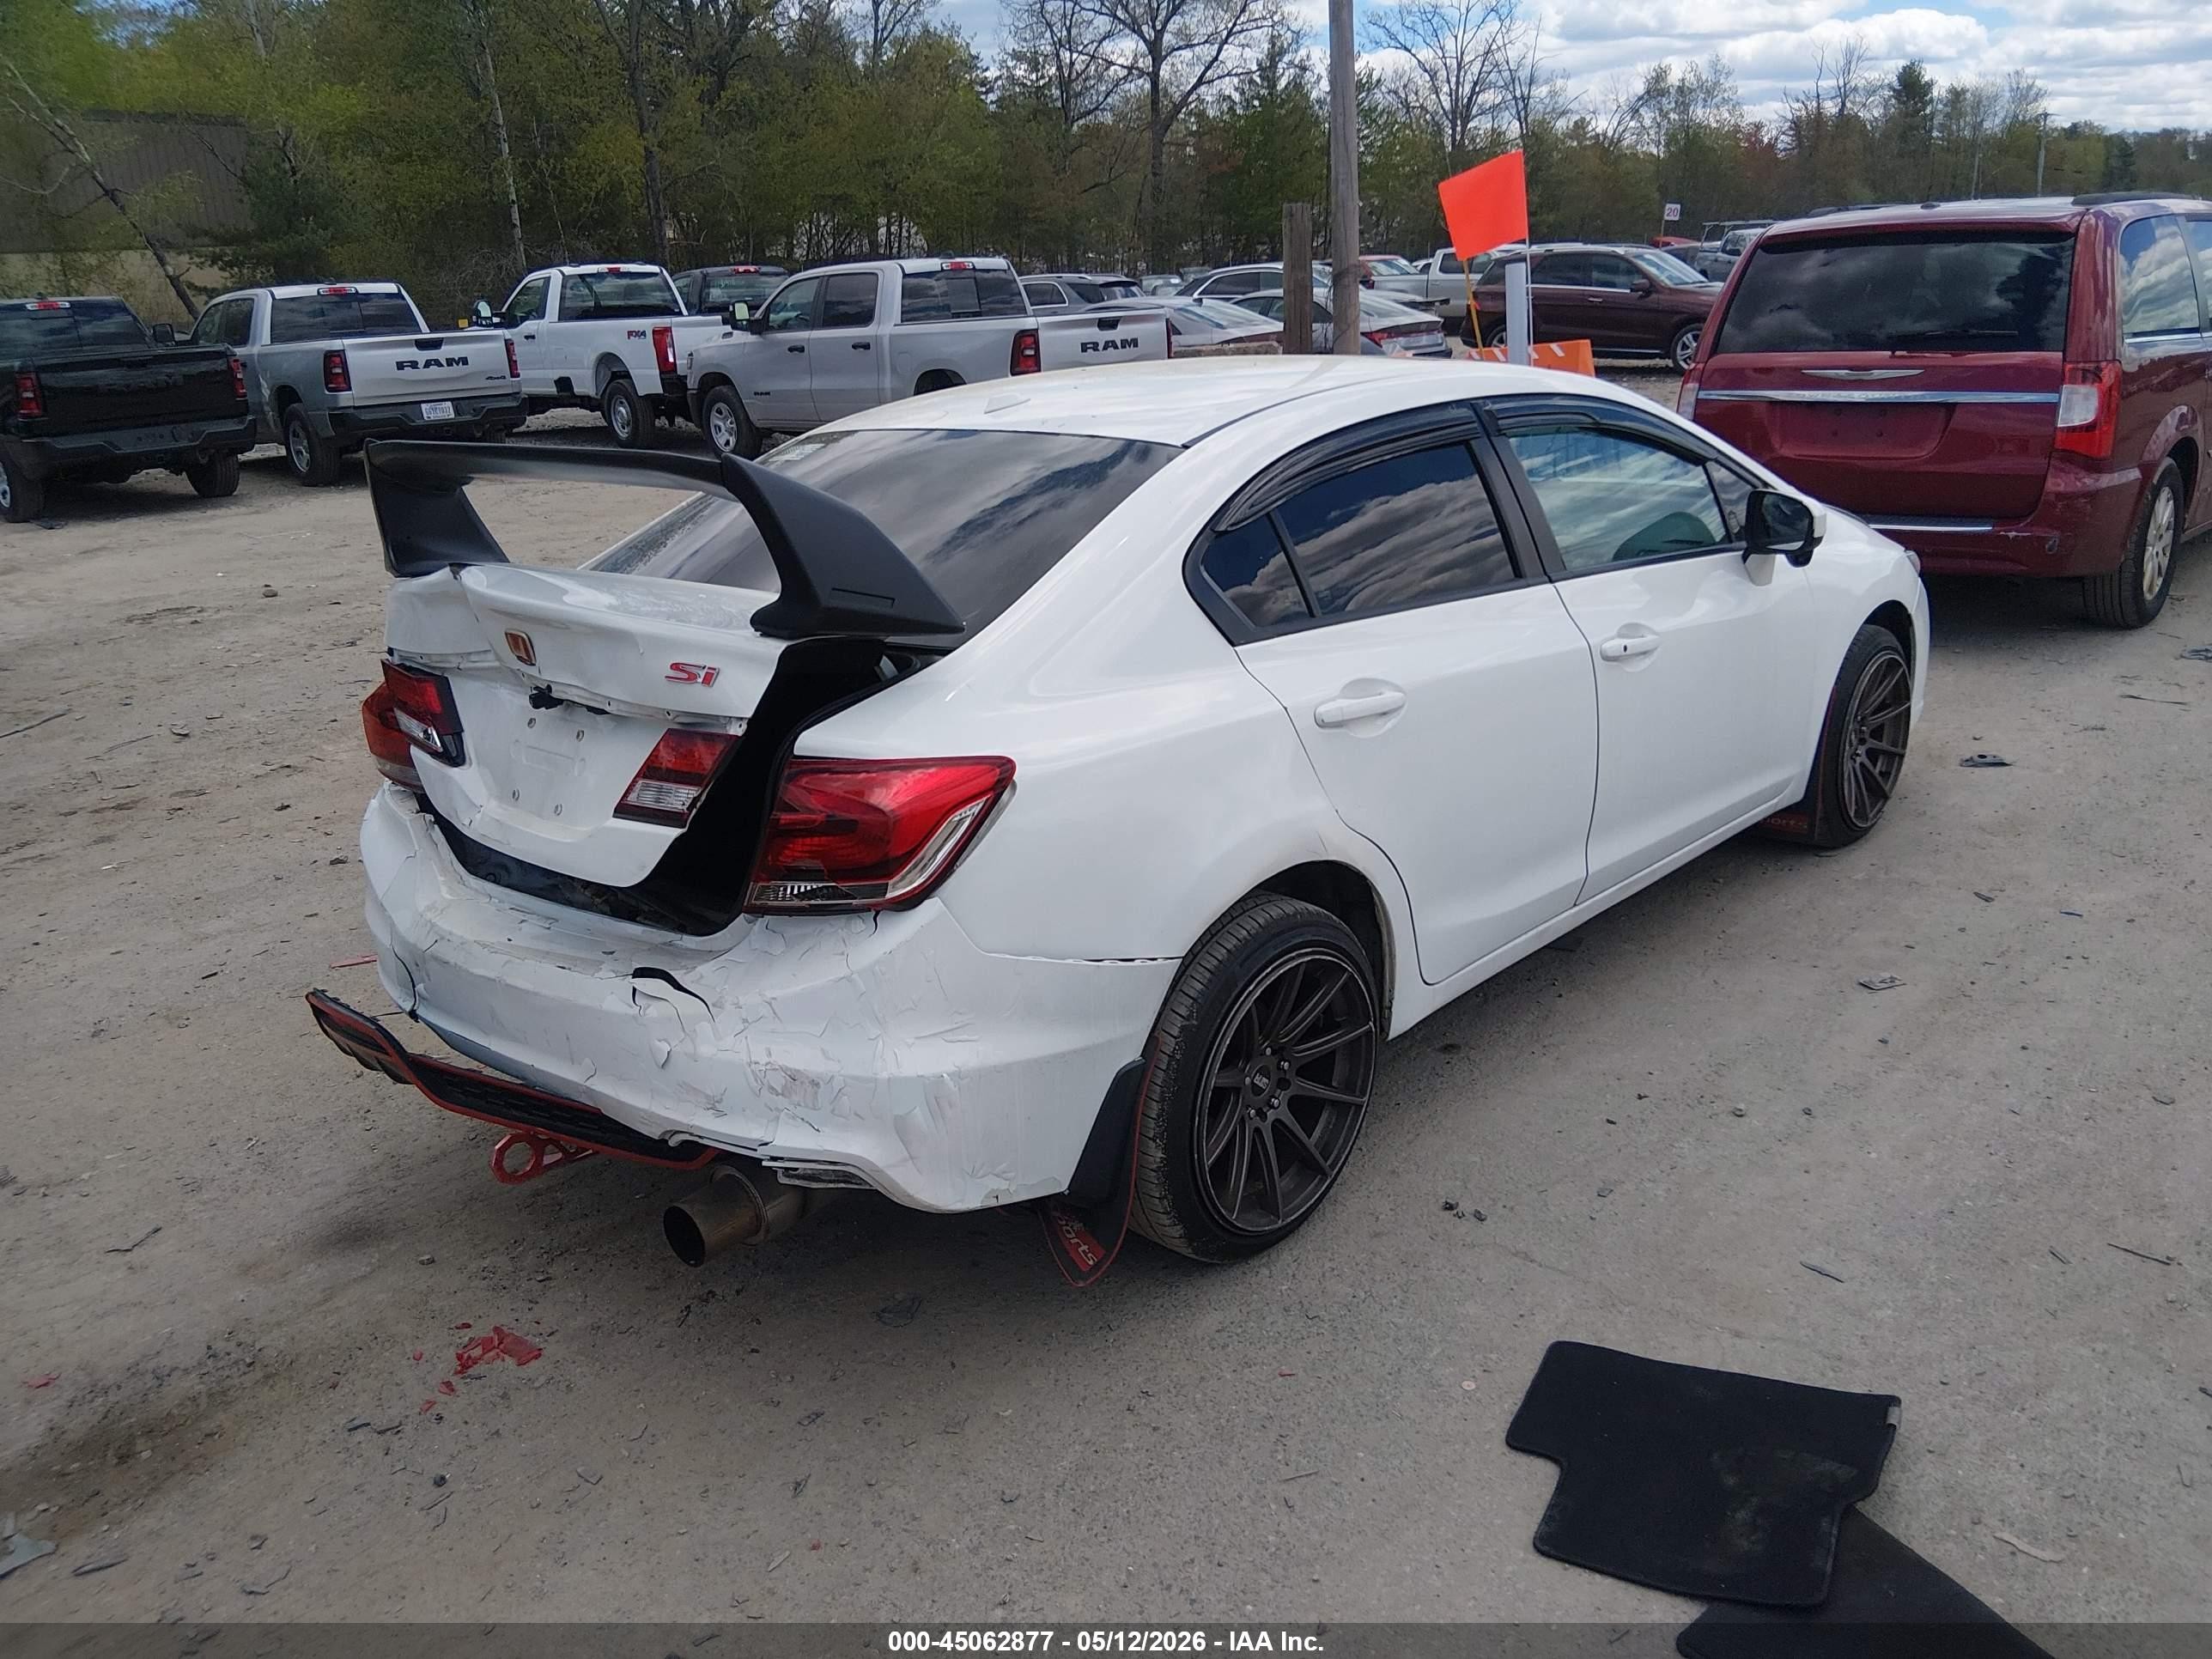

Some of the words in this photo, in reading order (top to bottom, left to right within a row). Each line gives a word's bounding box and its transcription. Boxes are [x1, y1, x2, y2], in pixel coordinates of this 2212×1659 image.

[1666, 207, 1679, 217] 20
[627, 330, 647, 340] FX4
[1080, 337, 1139, 353] RAM
[396, 356, 470, 371] RAM
[665, 662, 720, 687] Si
